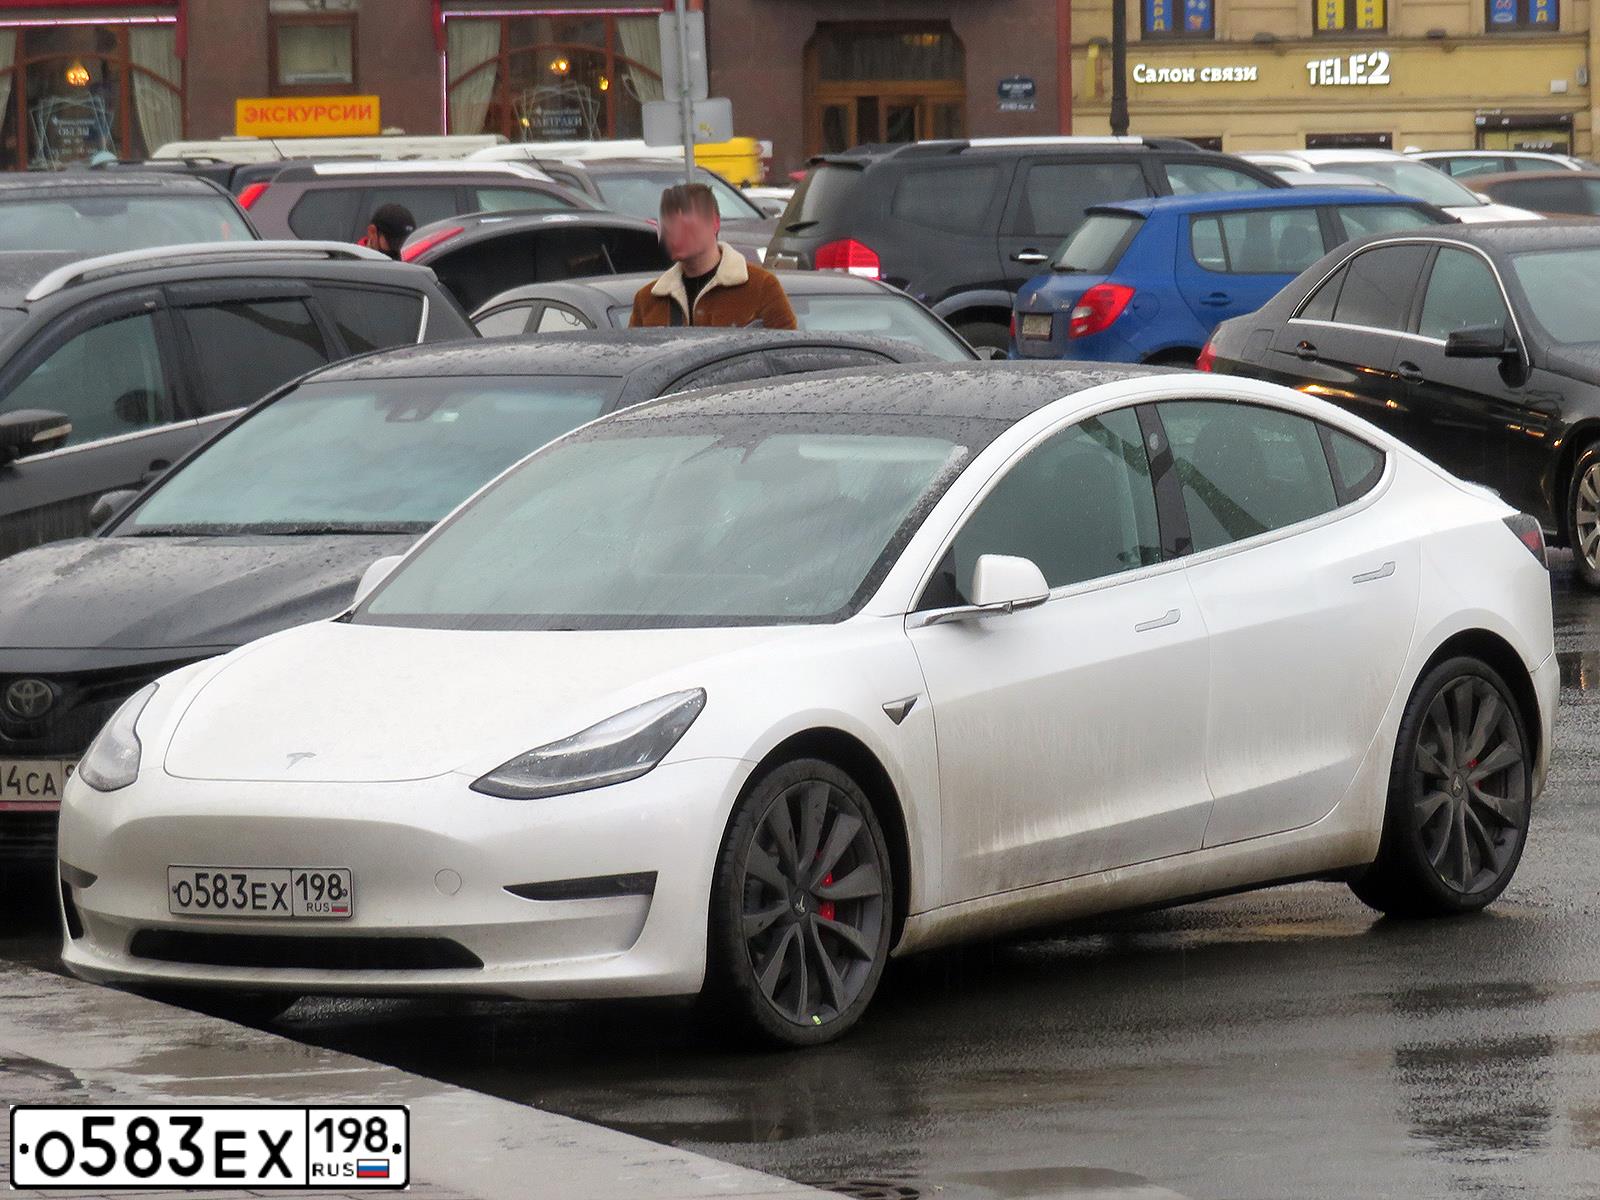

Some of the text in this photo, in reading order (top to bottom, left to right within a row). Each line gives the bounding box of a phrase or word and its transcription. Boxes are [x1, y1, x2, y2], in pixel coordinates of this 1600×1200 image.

[1132, 63, 1258, 83] Салон связи
[1306, 51, 1390, 85] TELE2
[244, 104, 372, 123] ЭКСКУРСИИ
[0, 765, 57, 796] 4СА
[177, 872, 342, 910] О583ЕХ 198
[306, 902, 330, 912] RUS
